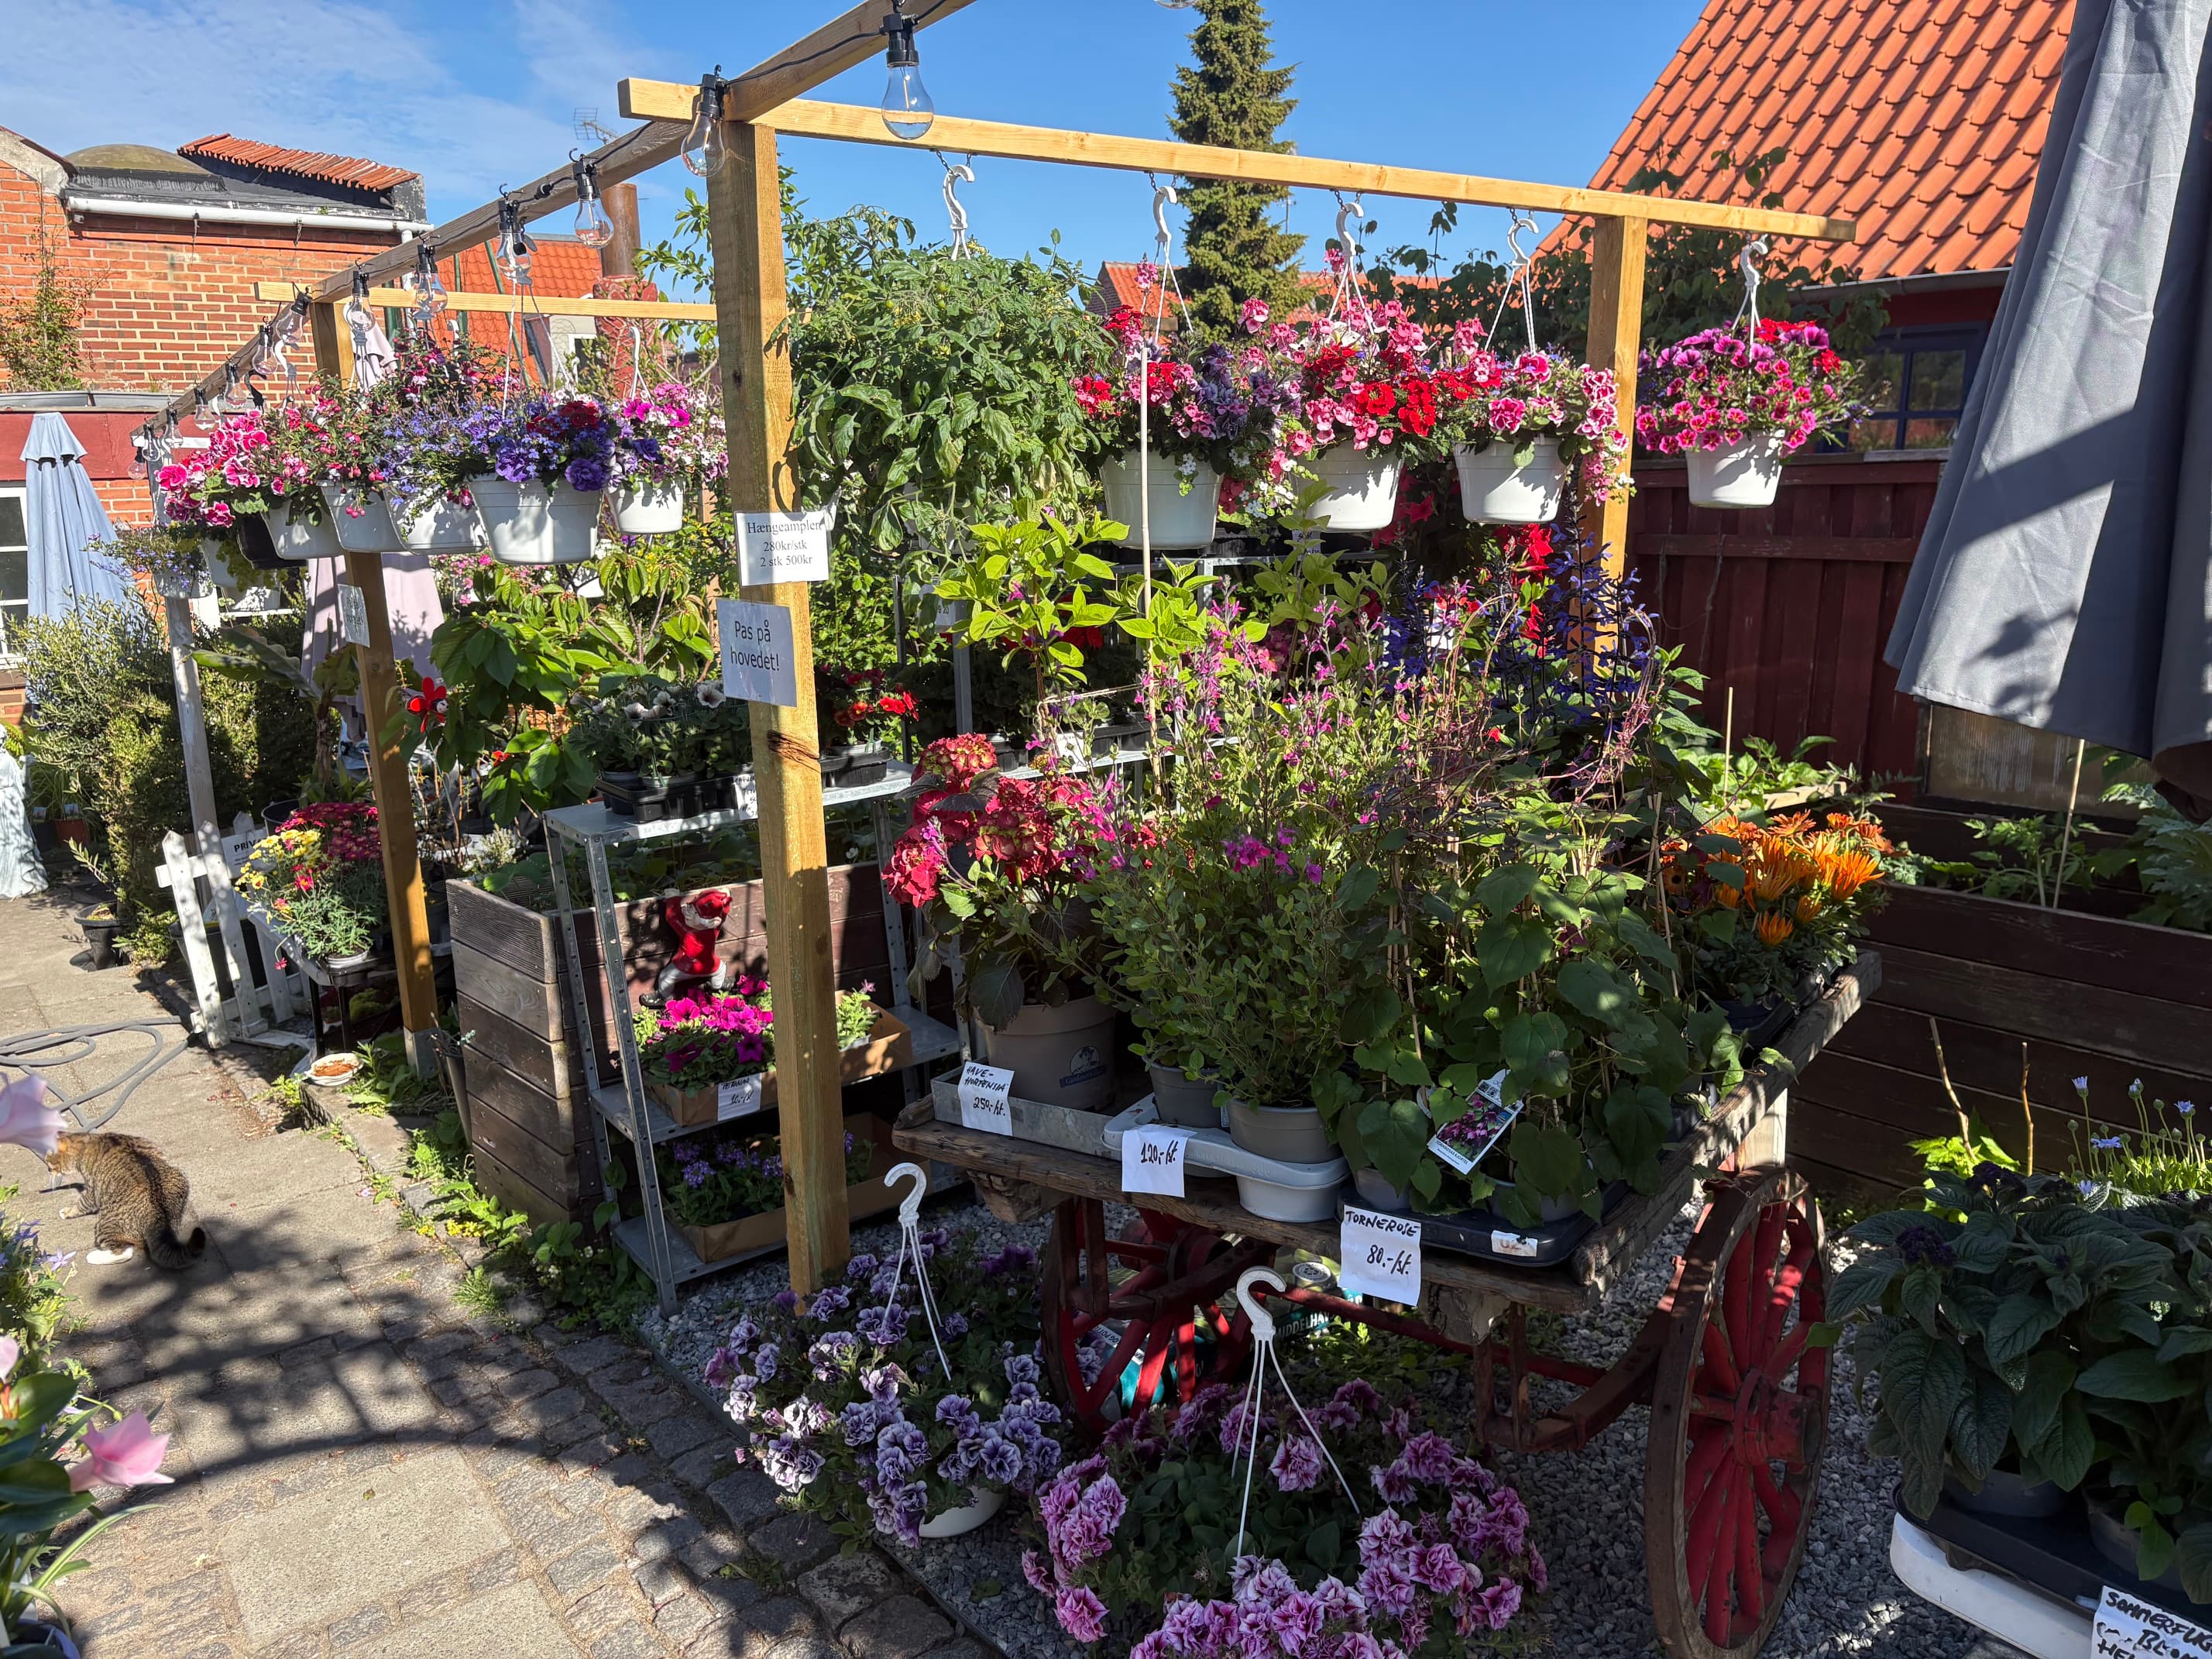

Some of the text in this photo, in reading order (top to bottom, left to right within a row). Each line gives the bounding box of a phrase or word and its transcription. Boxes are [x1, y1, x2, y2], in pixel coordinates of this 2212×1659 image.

[764, 540, 807, 551] 280kr/stk
[760, 554, 812, 567] 2 stk 500kr
[734, 619, 771, 644] Pas på
[730, 646, 780, 672] hovedet!
[964, 1077, 1006, 1092] HORTENSIA
[1345, 1211, 1420, 1237] TORNEROSE
[1276, 1312, 1335, 1338] MIDDELHAV
